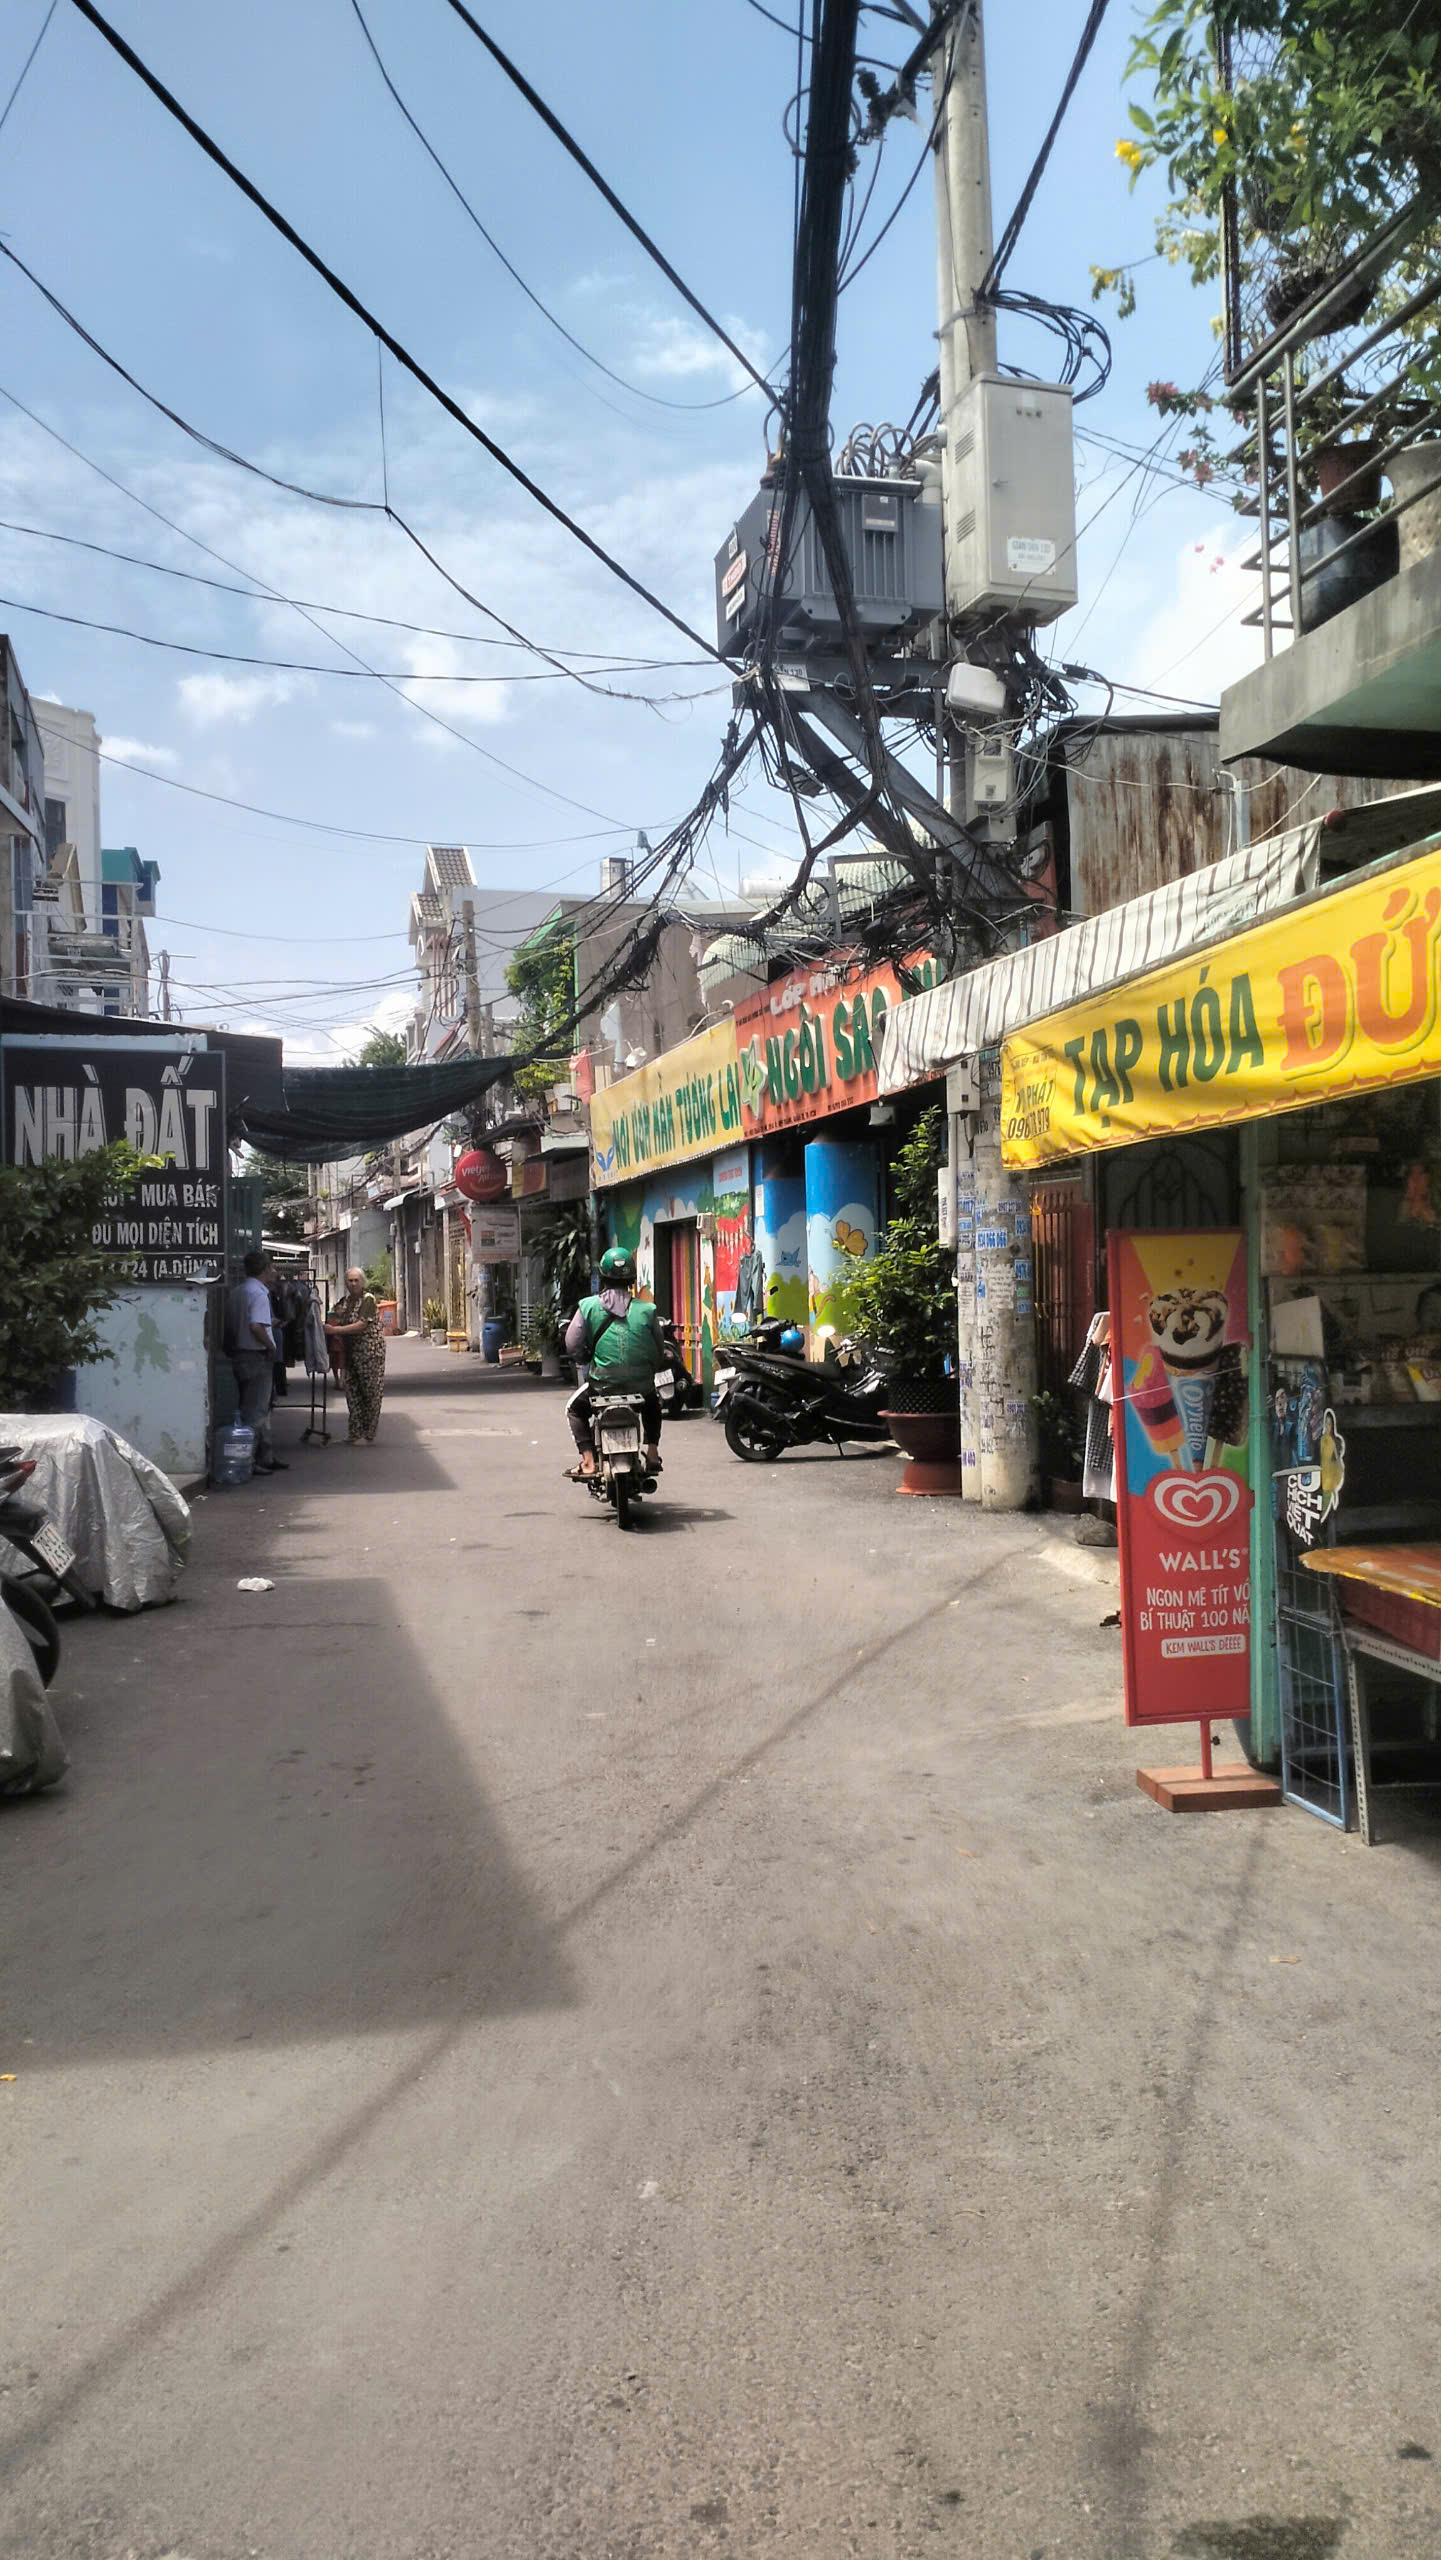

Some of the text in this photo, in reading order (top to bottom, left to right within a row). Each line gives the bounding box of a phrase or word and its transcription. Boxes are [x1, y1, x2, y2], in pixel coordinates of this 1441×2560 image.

[765, 1002, 832, 1106] NGÔI
[1064, 1018, 1143, 1129] TẠP
[1157, 966, 1265, 1093] HÓA
[718, 1062, 743, 1131] LAI
[15, 1055, 217, 1170] NHÀ ĐẤT
[141, 1184, 178, 1207] MUA
[117, 1222, 143, 1250] MỌI
[149, 1216, 182, 1250] DIỆN
[186, 1217, 219, 1246] TÍCH
[1158, 1548, 1241, 1572] WALL'S
[1146, 1587, 1183, 1608] NGON
[1187, 1586, 1207, 1607] MÊ
[1210, 1583, 1229, 1606] TÍT
[1139, 1604, 1250, 1632] BÍ THUẬT 100 NĂ
[1166, 1641, 1185, 1654] KEM
[1187, 1639, 1217, 1653] WALL'S
